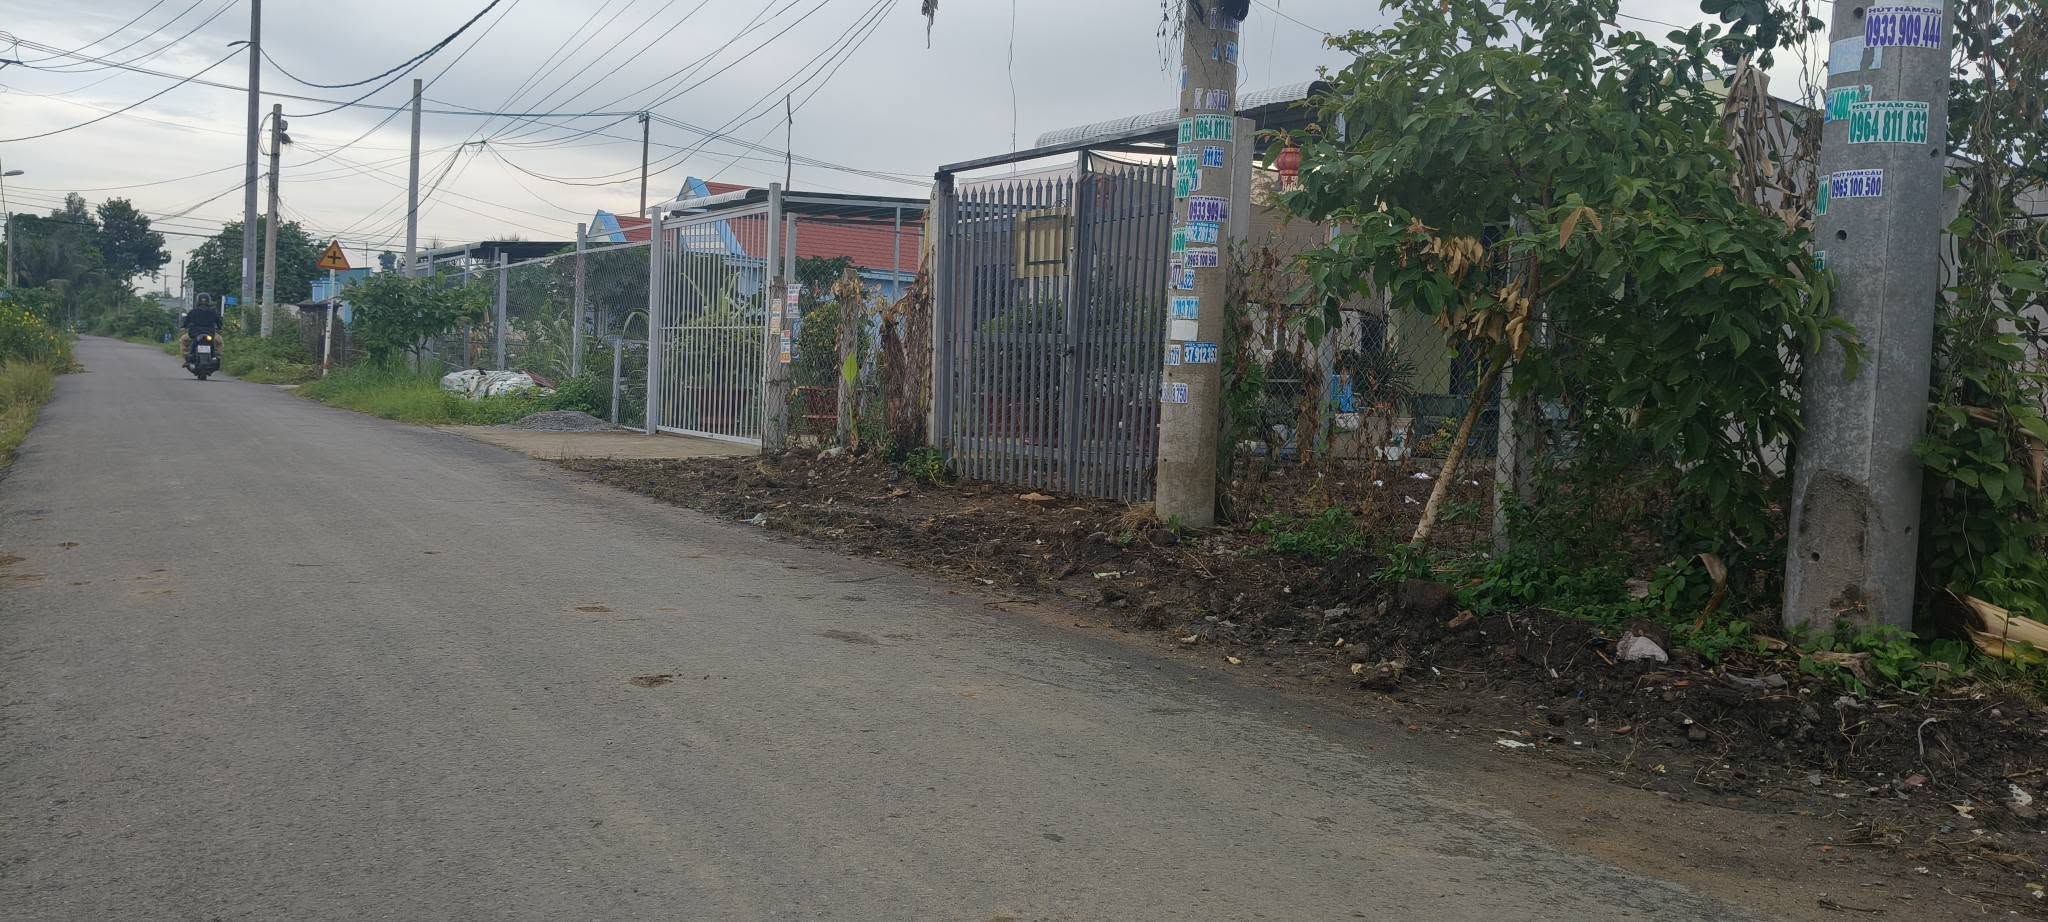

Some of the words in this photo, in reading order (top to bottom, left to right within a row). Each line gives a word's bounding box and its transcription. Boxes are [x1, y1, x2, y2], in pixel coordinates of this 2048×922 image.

[1865, 14, 1941, 48] 0933.909.444
[1849, 110, 1928, 143] 0964.811.833
[1831, 176, 1881, 198] 0965.100.500
